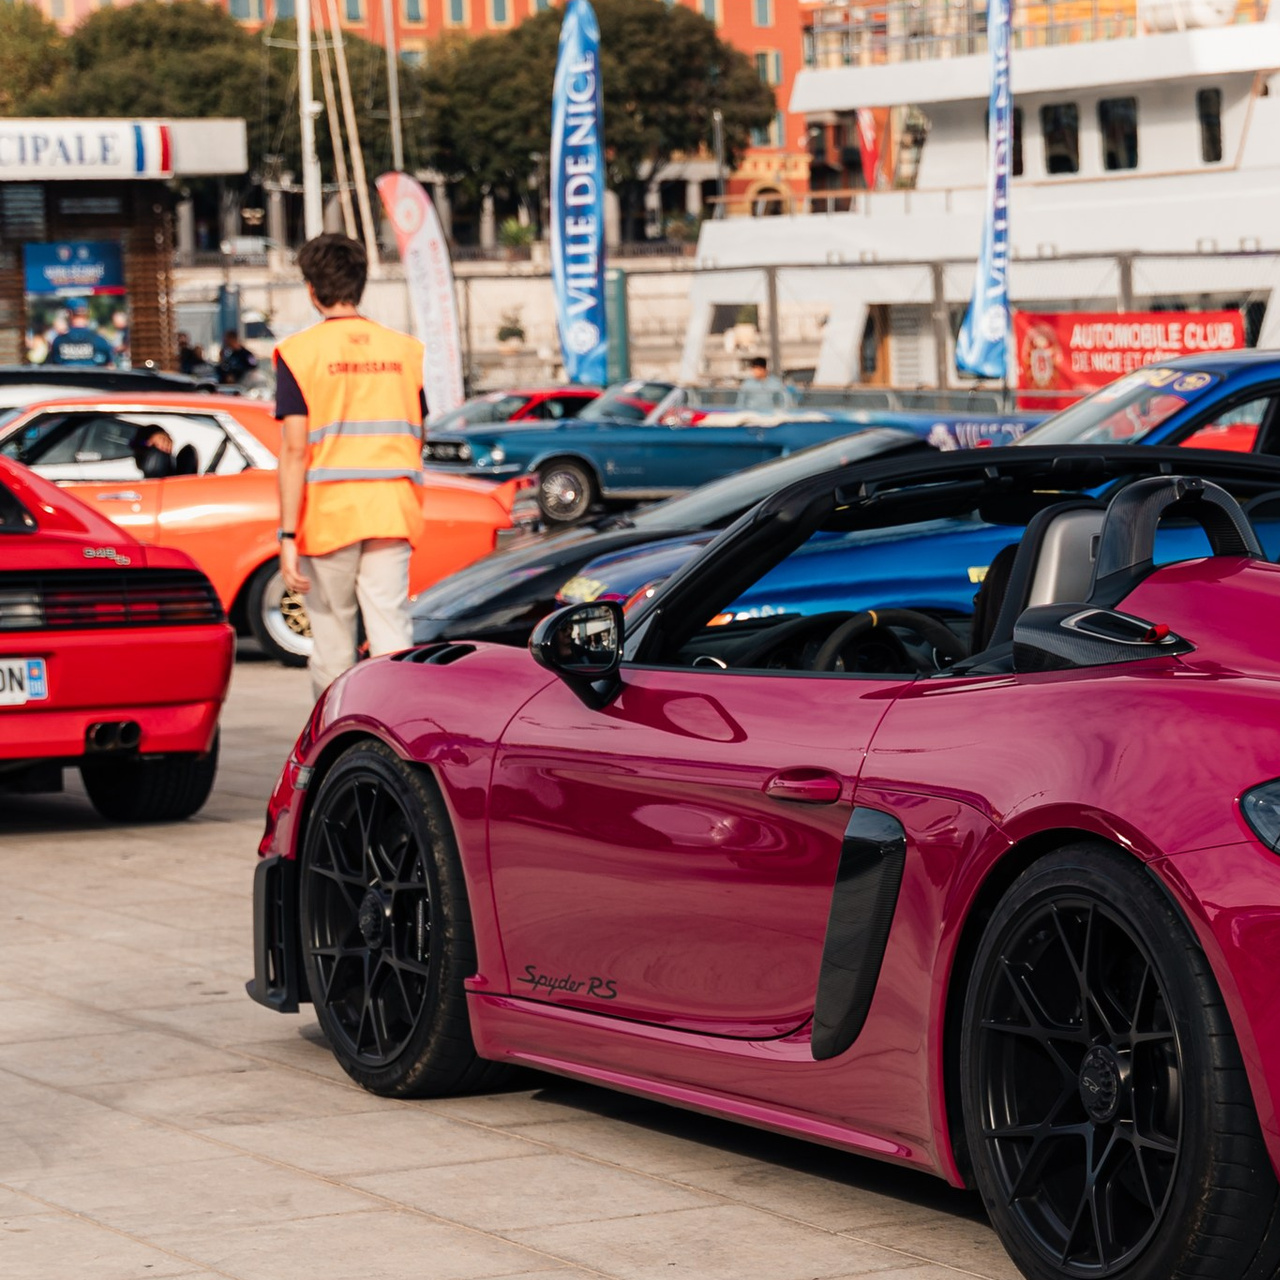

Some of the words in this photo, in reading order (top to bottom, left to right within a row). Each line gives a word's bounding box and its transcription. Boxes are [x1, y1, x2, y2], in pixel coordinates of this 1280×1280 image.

[565, 49, 597, 147] NICE
[565, 154, 597, 207] DE
[565, 215, 599, 316] VILLE
[1069, 322, 1183, 350] AUTOMOBILE
[1184, 322, 1236, 349] CLUB
[1071, 351, 1090, 372] DE
[1090, 351, 1123, 373] NICE
[1124, 351, 1142, 372] ET
[516, 964, 585, 997] Spyder
[586, 976, 618, 999] RS
